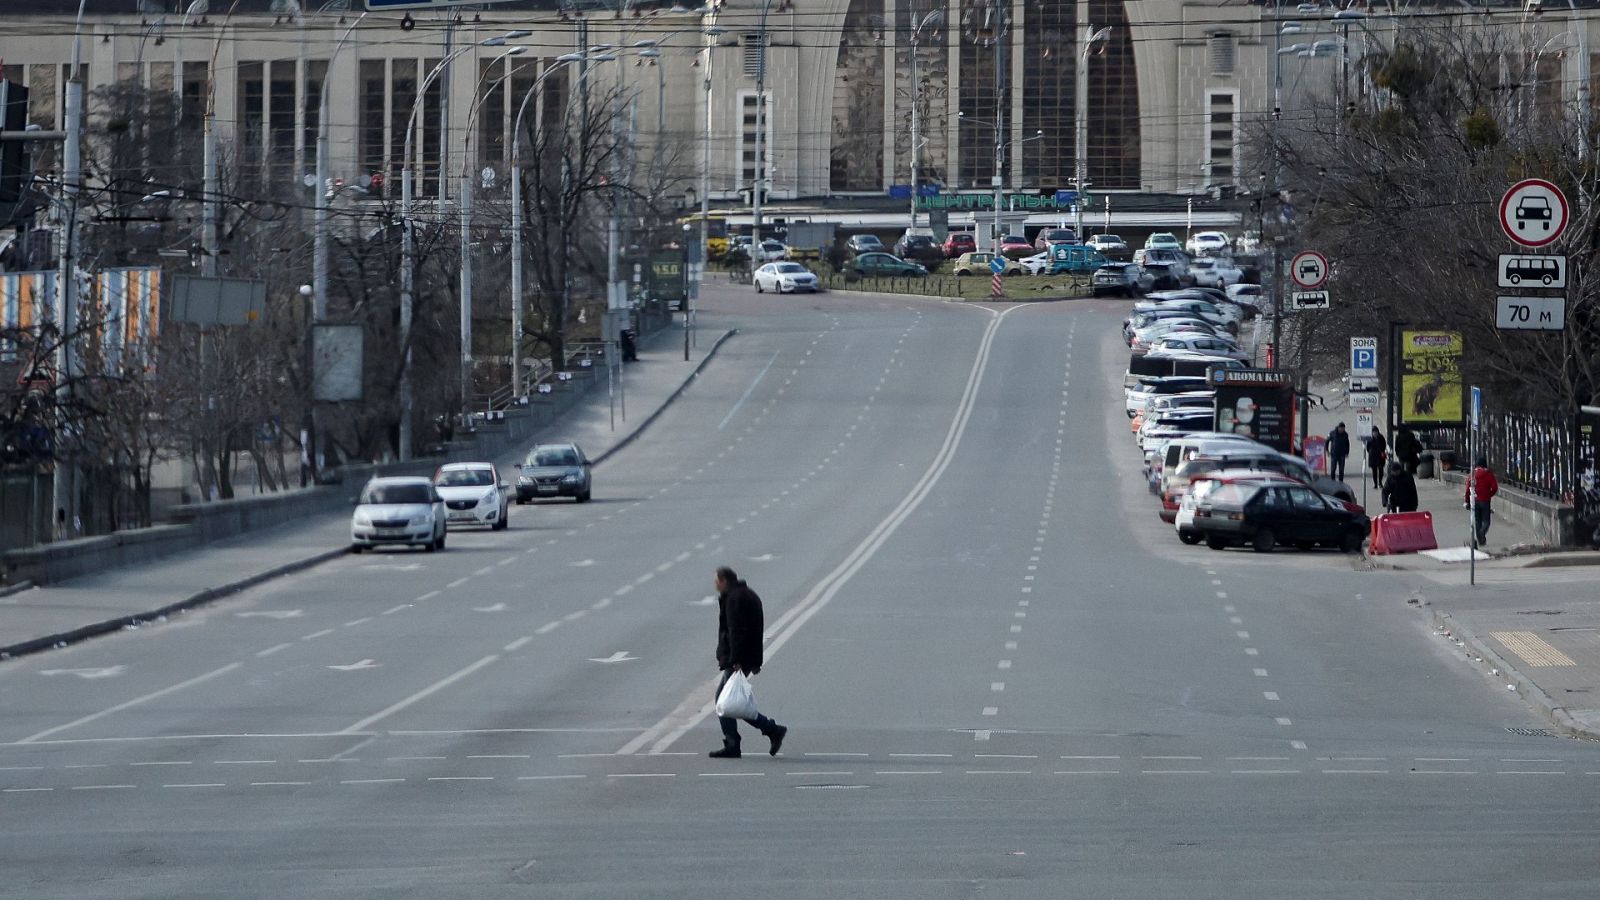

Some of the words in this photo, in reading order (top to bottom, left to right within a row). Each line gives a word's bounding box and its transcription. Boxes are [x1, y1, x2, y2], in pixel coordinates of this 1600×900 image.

[916, 194, 1092, 208] ЦЕНТРАЛЬН
[1508, 305, 1530, 322] 70
[1353, 339, 1376, 348] ЗОНА
[1227, 372, 1263, 382] AROMA
